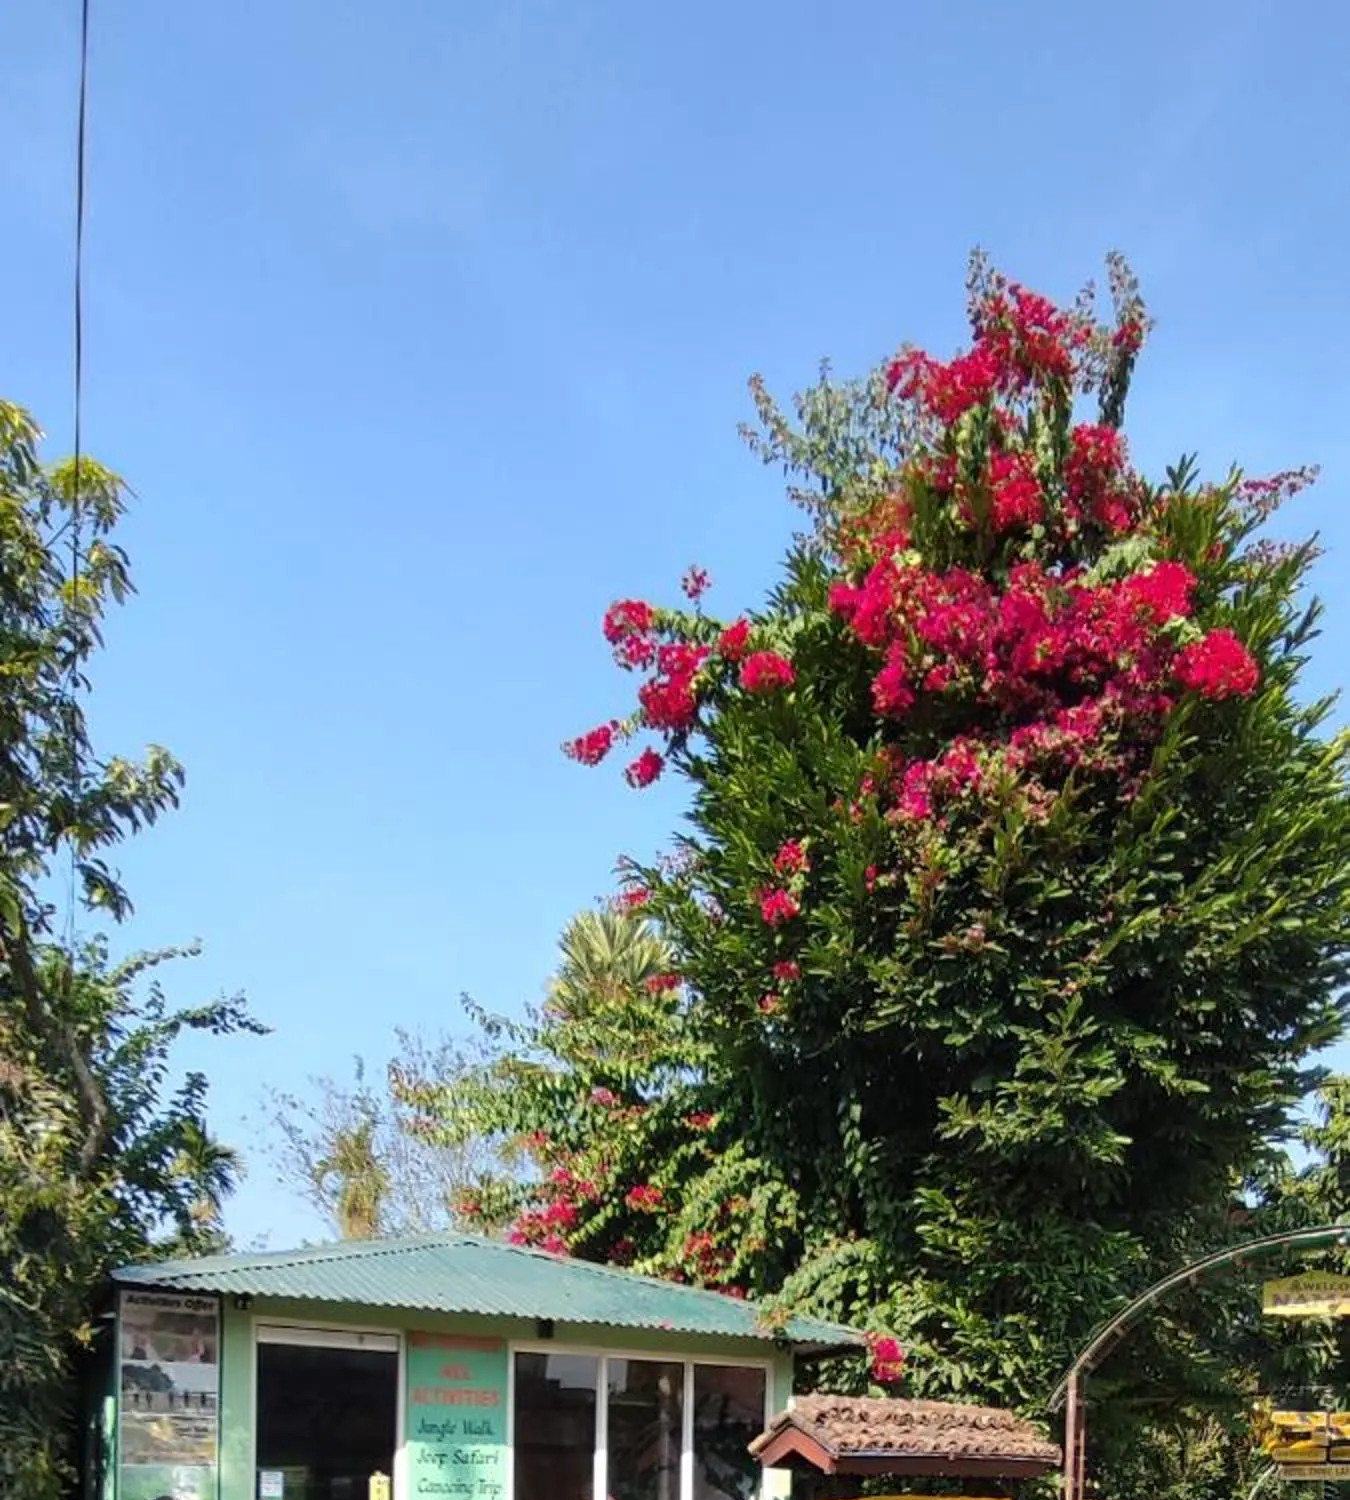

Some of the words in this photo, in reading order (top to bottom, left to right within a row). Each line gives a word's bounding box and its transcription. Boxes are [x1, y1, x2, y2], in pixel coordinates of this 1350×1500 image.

[413, 1386, 500, 1407] ACTIVITIES
[417, 1416, 457, 1442] Jungle
[462, 1418, 495, 1436] Walk
[416, 1448, 449, 1470] Jeep
[452, 1447, 499, 1465] Safari
